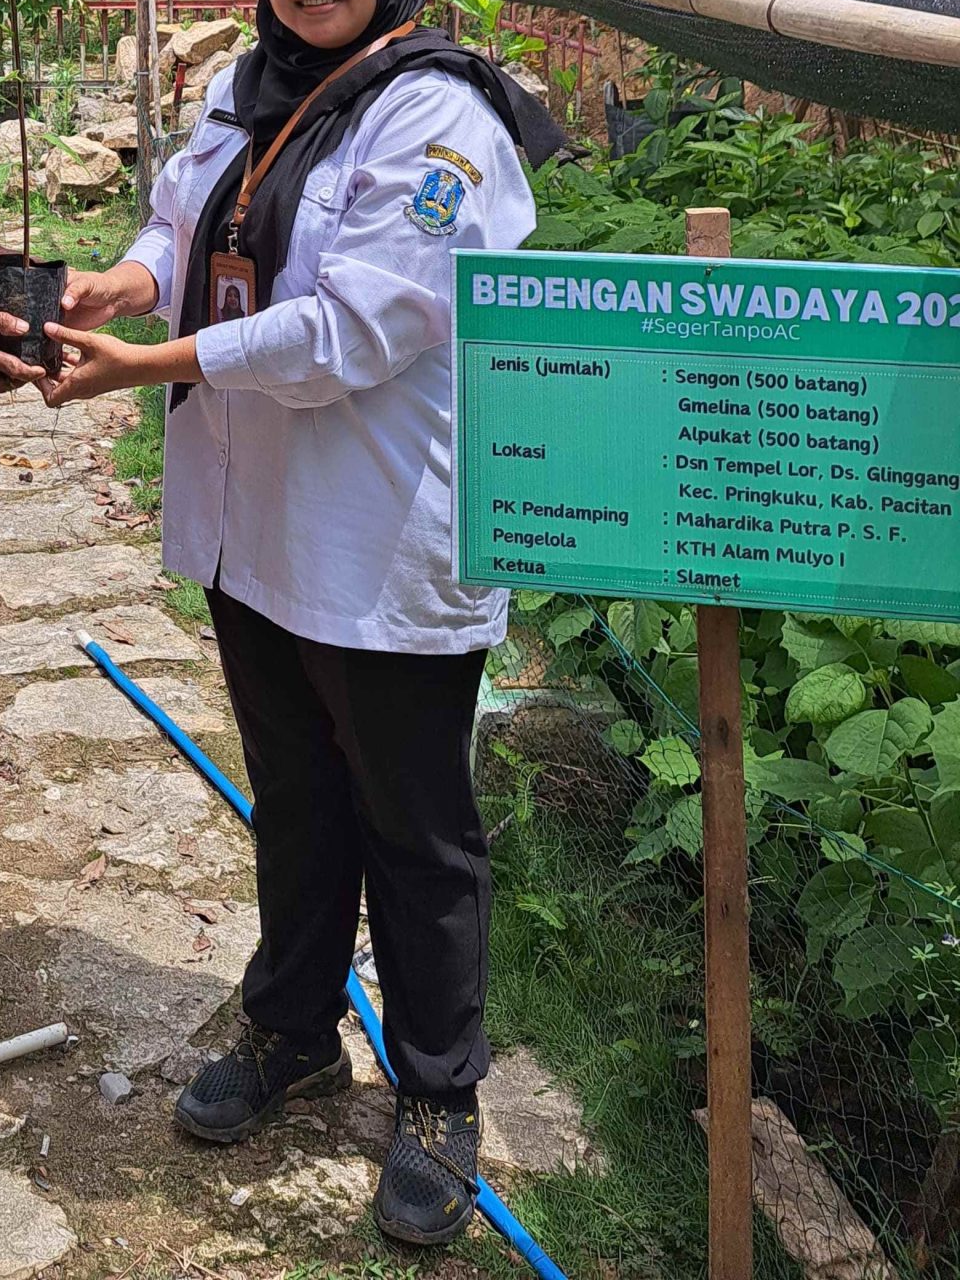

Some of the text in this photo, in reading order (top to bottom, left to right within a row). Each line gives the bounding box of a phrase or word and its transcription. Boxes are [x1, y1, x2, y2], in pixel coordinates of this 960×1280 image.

[472, 273, 672, 314] BEDENGAN
[679, 281, 889, 324] SWADAYA
[641, 318, 801, 342] #SegerTanpoAC
[490, 357, 530, 372] Jenis
[535, 357, 611, 379] (jumlah)
[675, 369, 740, 389] Sengon
[746, 371, 788, 390] (500
[795, 375, 867, 397] batang)
[678, 398, 879, 426] Gmelina (500 batang)
[678, 426, 879, 456] Alpukat (500 batang)
[492, 442, 546, 460] Lokasi
[676, 455, 708, 471] Dsn
[714, 457, 782, 478] Tempel
[788, 462, 823, 480] Lor,
[830, 464, 859, 480] Ds.
[867, 466, 960, 490] Glinggang
[679, 483, 952, 516] Kec. Pringkuku, Kab. Pacitan
[492, 499, 516, 515] PK
[522, 502, 629, 526] Pendamping
[676, 512, 774, 533] Mahardika
[780, 519, 831, 537] Putra
[838, 523, 856, 539] P.
[863, 525, 881, 541] S.
[889, 527, 907, 542] F.
[493, 528, 577, 548] Pengelola
[676, 540, 716, 557] KTH
[722, 543, 770, 562] Alam
[776, 547, 834, 568] Mulyo
[493, 557, 546, 575] Ketua
[676, 569, 741, 588] Slamet
